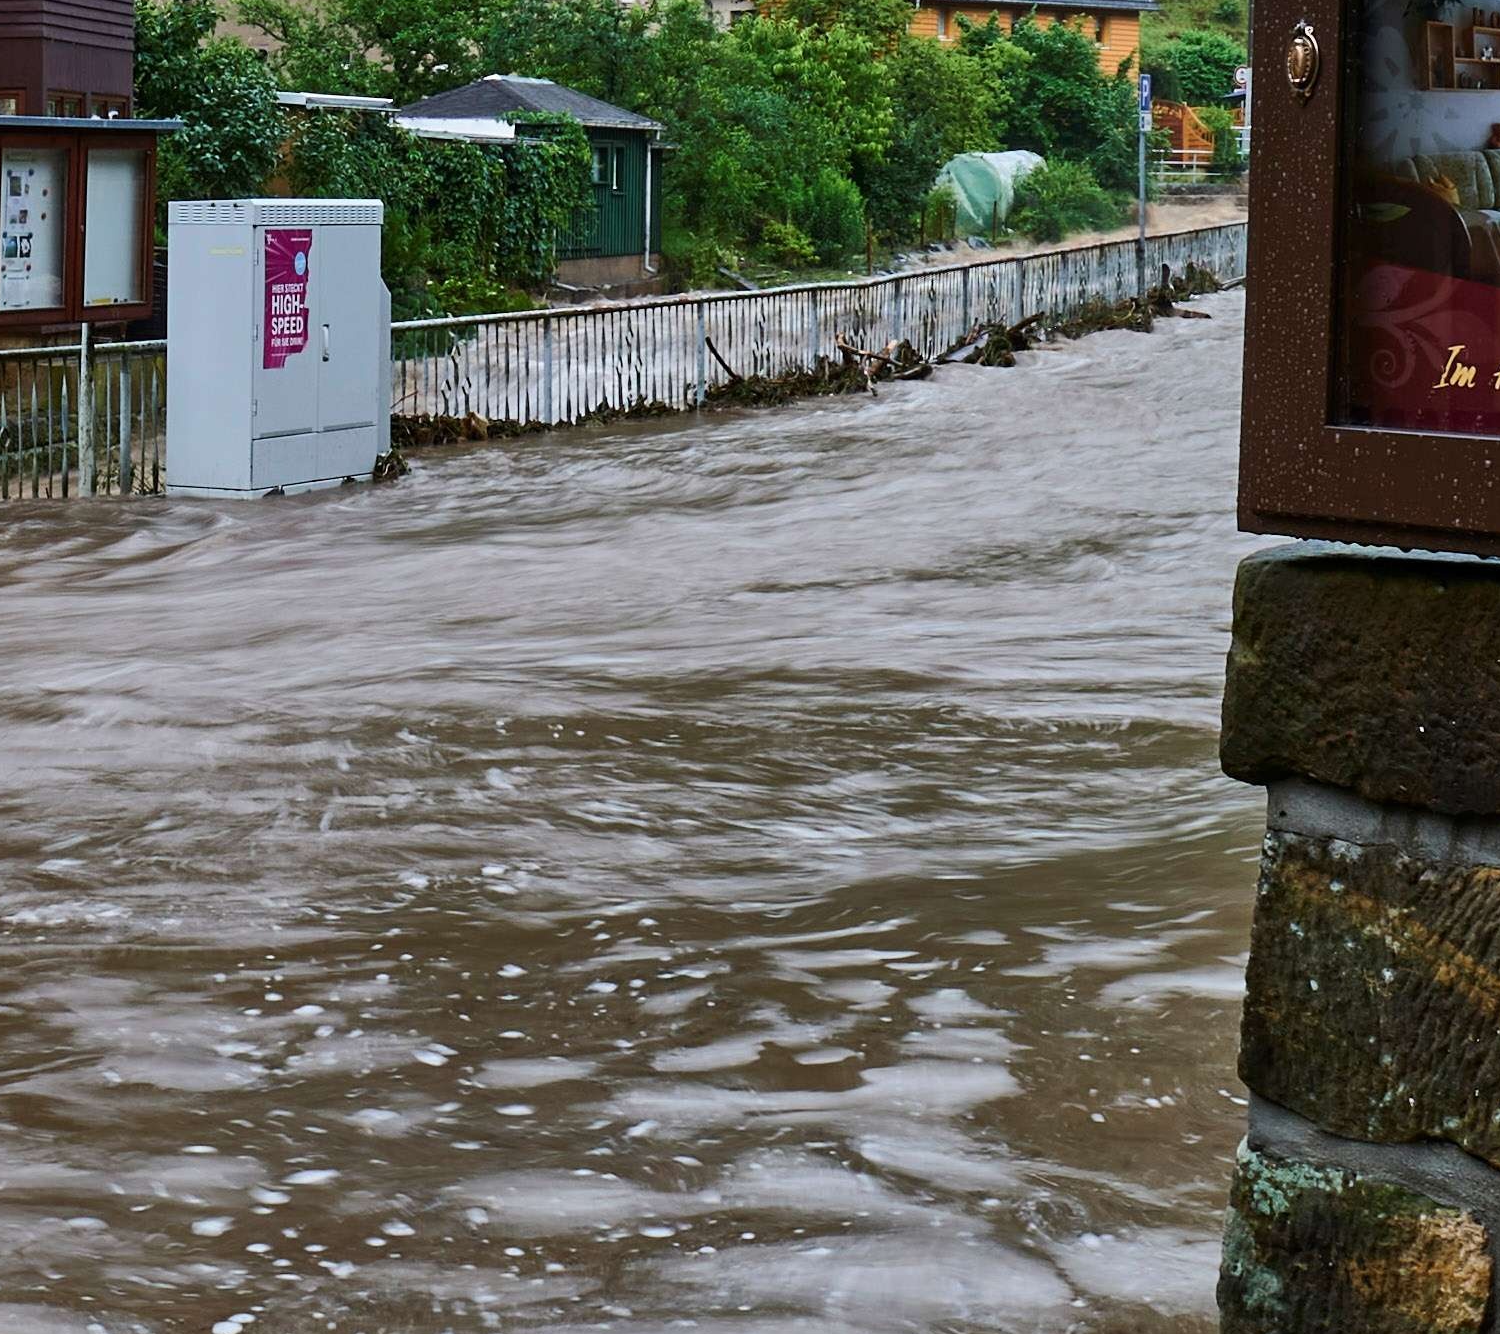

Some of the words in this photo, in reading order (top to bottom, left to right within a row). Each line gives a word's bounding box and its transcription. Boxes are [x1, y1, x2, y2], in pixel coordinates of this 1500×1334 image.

[1142, 79, 1149, 107] P
[271, 293, 305, 316] HIGH-
[271, 316, 304, 336] SPEED
[1432, 344, 1476, 390] Im
